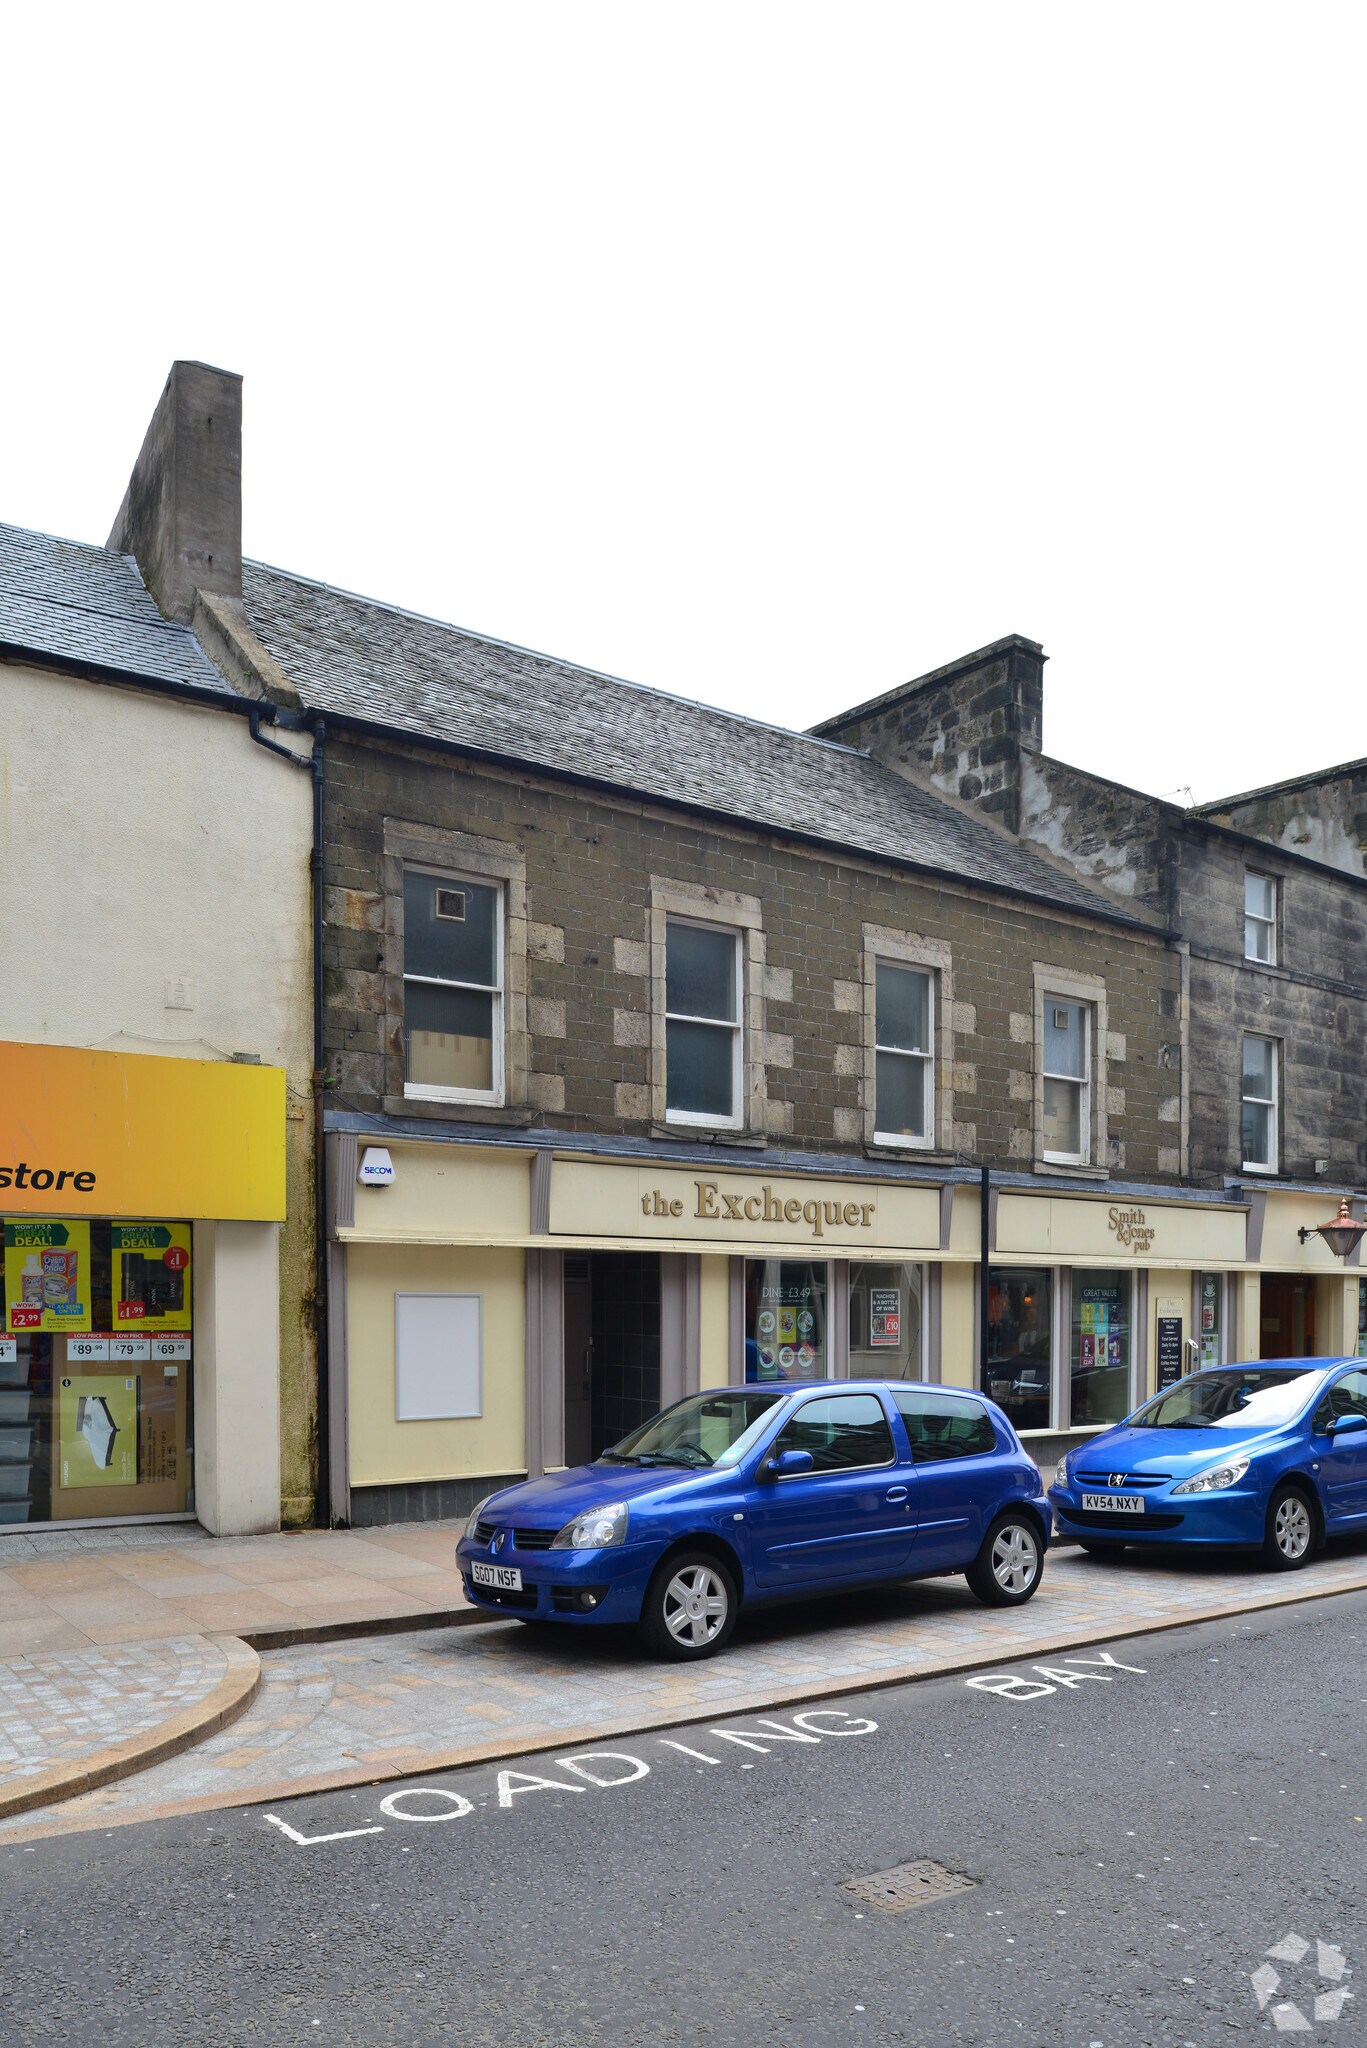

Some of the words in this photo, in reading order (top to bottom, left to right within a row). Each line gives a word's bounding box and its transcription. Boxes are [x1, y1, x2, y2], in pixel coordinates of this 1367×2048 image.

[0, 1163, 96, 1192] store
[641, 1190, 684, 1217] the
[694, 1180, 876, 1237] Exchequer
[1108, 1206, 1145, 1231] Smith
[15, 1229, 51, 1237] GREAT
[121, 1231, 155, 1239] GREAT
[15, 1236, 52, 1247] DEAL!
[121, 1239, 156, 1248] DEAL!
[1133, 1238, 1150, 1254] pub
[44, 1264, 65, 1272] Pride
[762, 1287, 784, 1298] DINE
[788, 1287, 811, 1298] £3.49
[1083, 1289, 1100, 1297] GREAT
[1101, 1289, 1118, 1297] VALUE
[120, 1306, 144, 1318] £1.99
[13, 1314, 39, 1325] £2.99
[886, 1321, 898, 1331] £10
[1086, 1495, 1113, 1509] KV54
[1116, 1497, 1139, 1510] NXY
[474, 1565, 495, 1584] SG07
[497, 1569, 516, 1587] NSF
[262, 1710, 879, 1846] LOADING
[964, 1652, 1148, 1701] BAY
